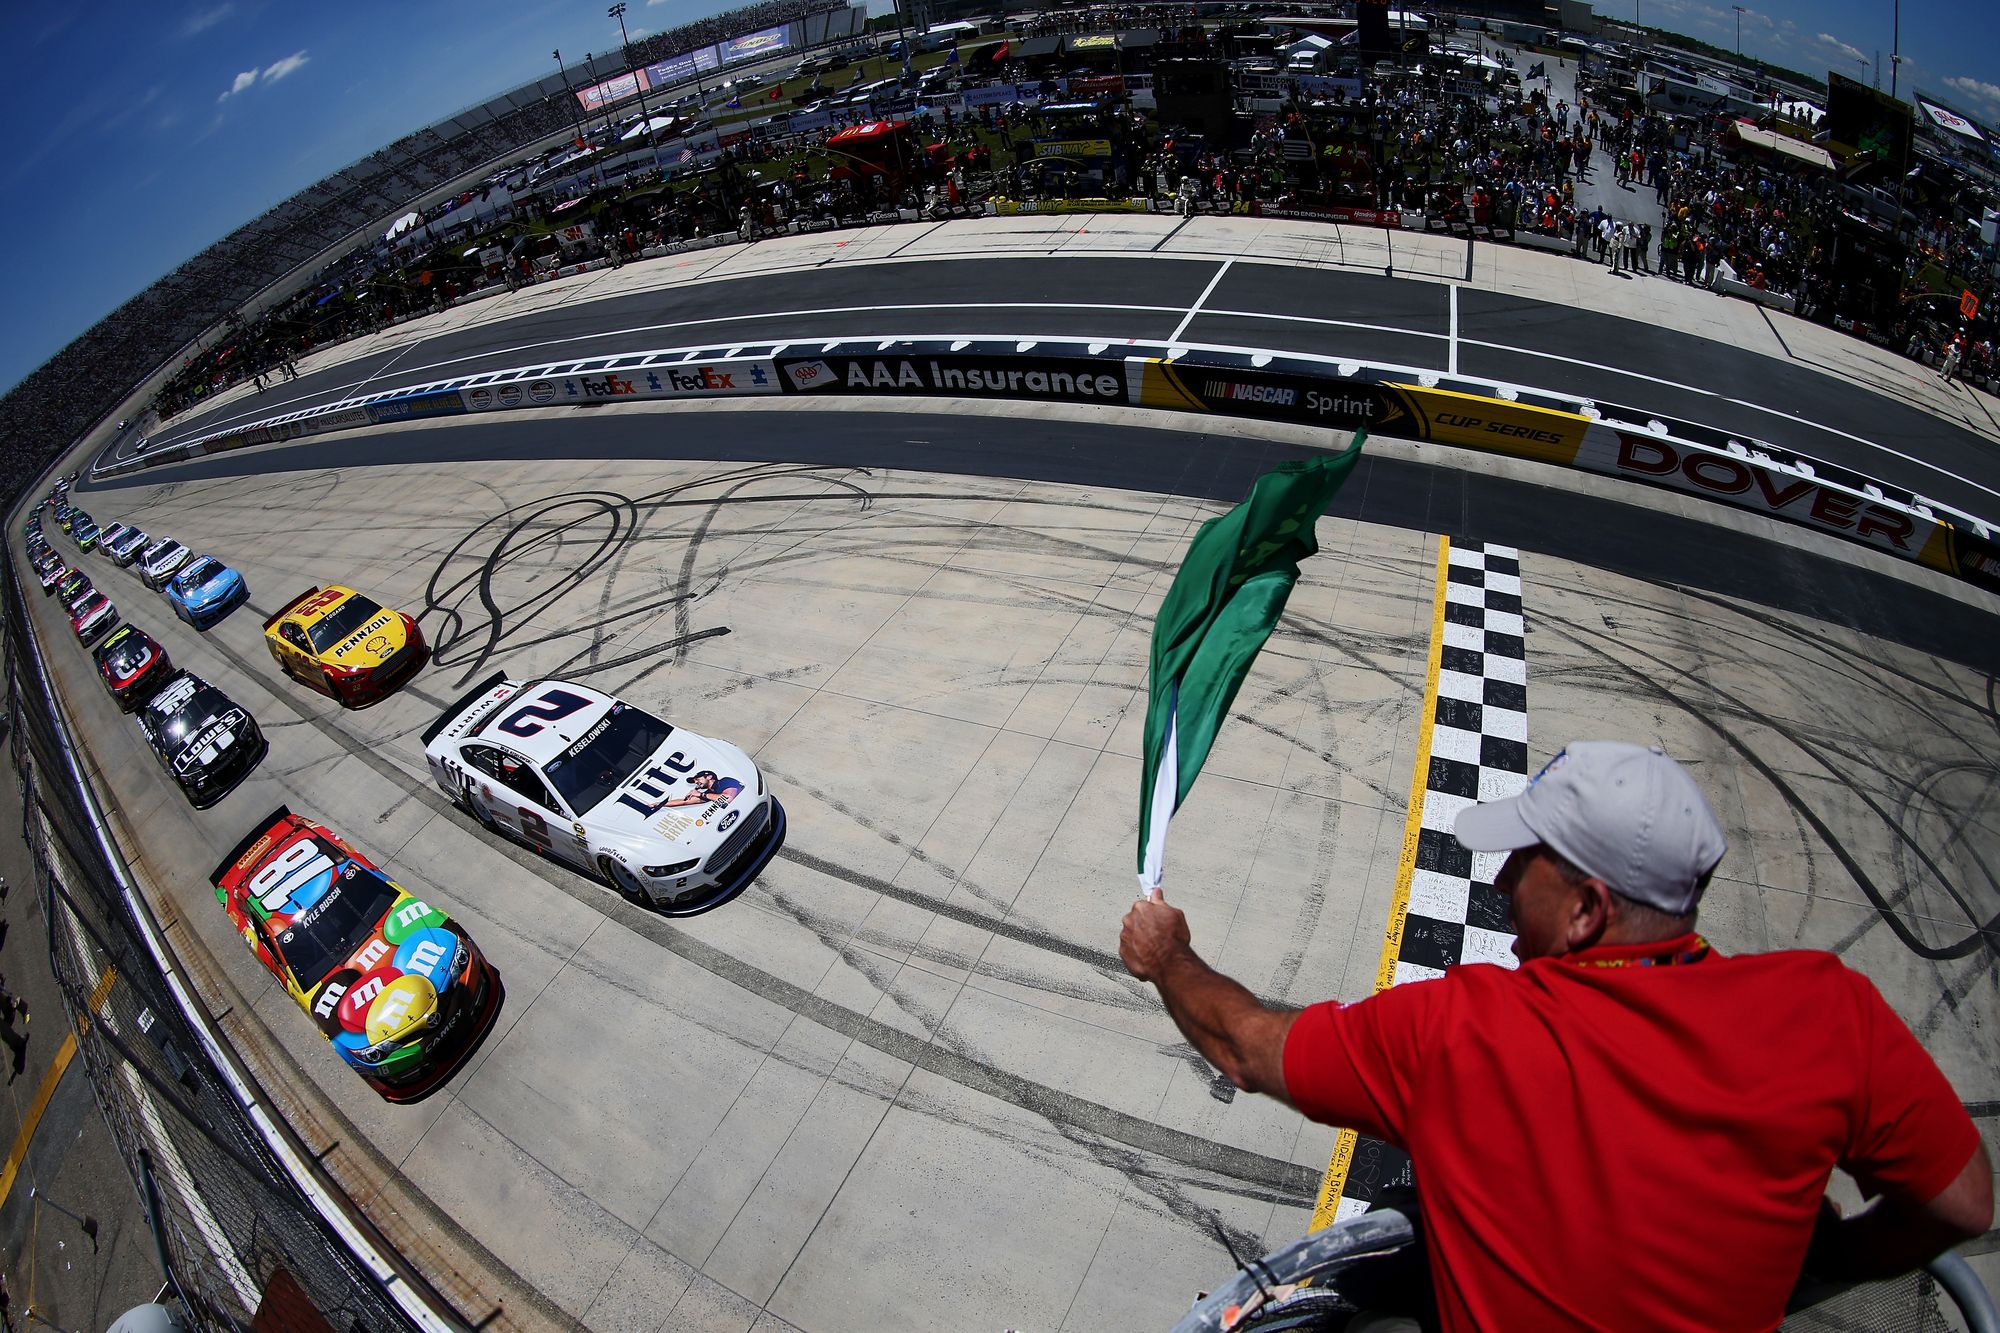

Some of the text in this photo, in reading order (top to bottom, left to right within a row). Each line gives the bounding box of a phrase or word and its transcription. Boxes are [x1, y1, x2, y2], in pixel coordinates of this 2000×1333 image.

[730, 34, 780, 50] SUNOCO
[1040, 143, 1088, 157] SUBWAY
[1323, 144, 1343, 157] 24
[1882, 176, 1915, 199] Sprint
[876, 211, 898, 220] Cessna
[1017, 200, 1063, 212] SUBWAY
[1131, 199, 1143, 208] 99
[1232, 201, 1250, 214] 24
[1263, 208, 1289, 216] DRIVE
[1317, 212, 1349, 221] HUNGER
[563, 225, 586, 242] 3M
[809, 219, 830, 229] Cessna
[714, 234, 726, 243] 33
[575, 263, 588, 274] 3M
[1800, 302, 1817, 318] 11
[580, 374, 637, 397] FedEx
[667, 366, 736, 391] FedEx
[794, 360, 1120, 397] AAA AAA Insurance
[1231, 383, 1374, 417] NASCAR Sprint
[1434, 412, 1566, 445] CUP SERIES
[1614, 430, 1915, 551] DOVER
[335, 615, 392, 658] PENNZOIL
[497, 689, 595, 738] 2
[181, 712, 237, 764] LOWE'S
[568, 718, 612, 758] KESELOWSKI
[613, 751, 696, 821] Lite
[701, 794, 730, 821] PENNZOIL
[719, 812, 738, 830] Ford
[517, 805, 554, 849] 2
[653, 812, 679, 835] LUKE
[663, 814, 694, 842] BRYAN
[249, 837, 336, 913] 18
[676, 876, 688, 888] 2
[303, 887, 342, 929] KYLE BUSCH
[396, 900, 433, 928] m
[355, 936, 390, 972] m
[406, 940, 447, 978] m
[314, 981, 348, 1020] m
[351, 975, 386, 1010] m
[376, 988, 416, 1030] m
[425, 1008, 463, 1053] CAMRY
[377, 1064, 390, 1076] 18
[1324, 1179, 1341, 1211] BRYAN
